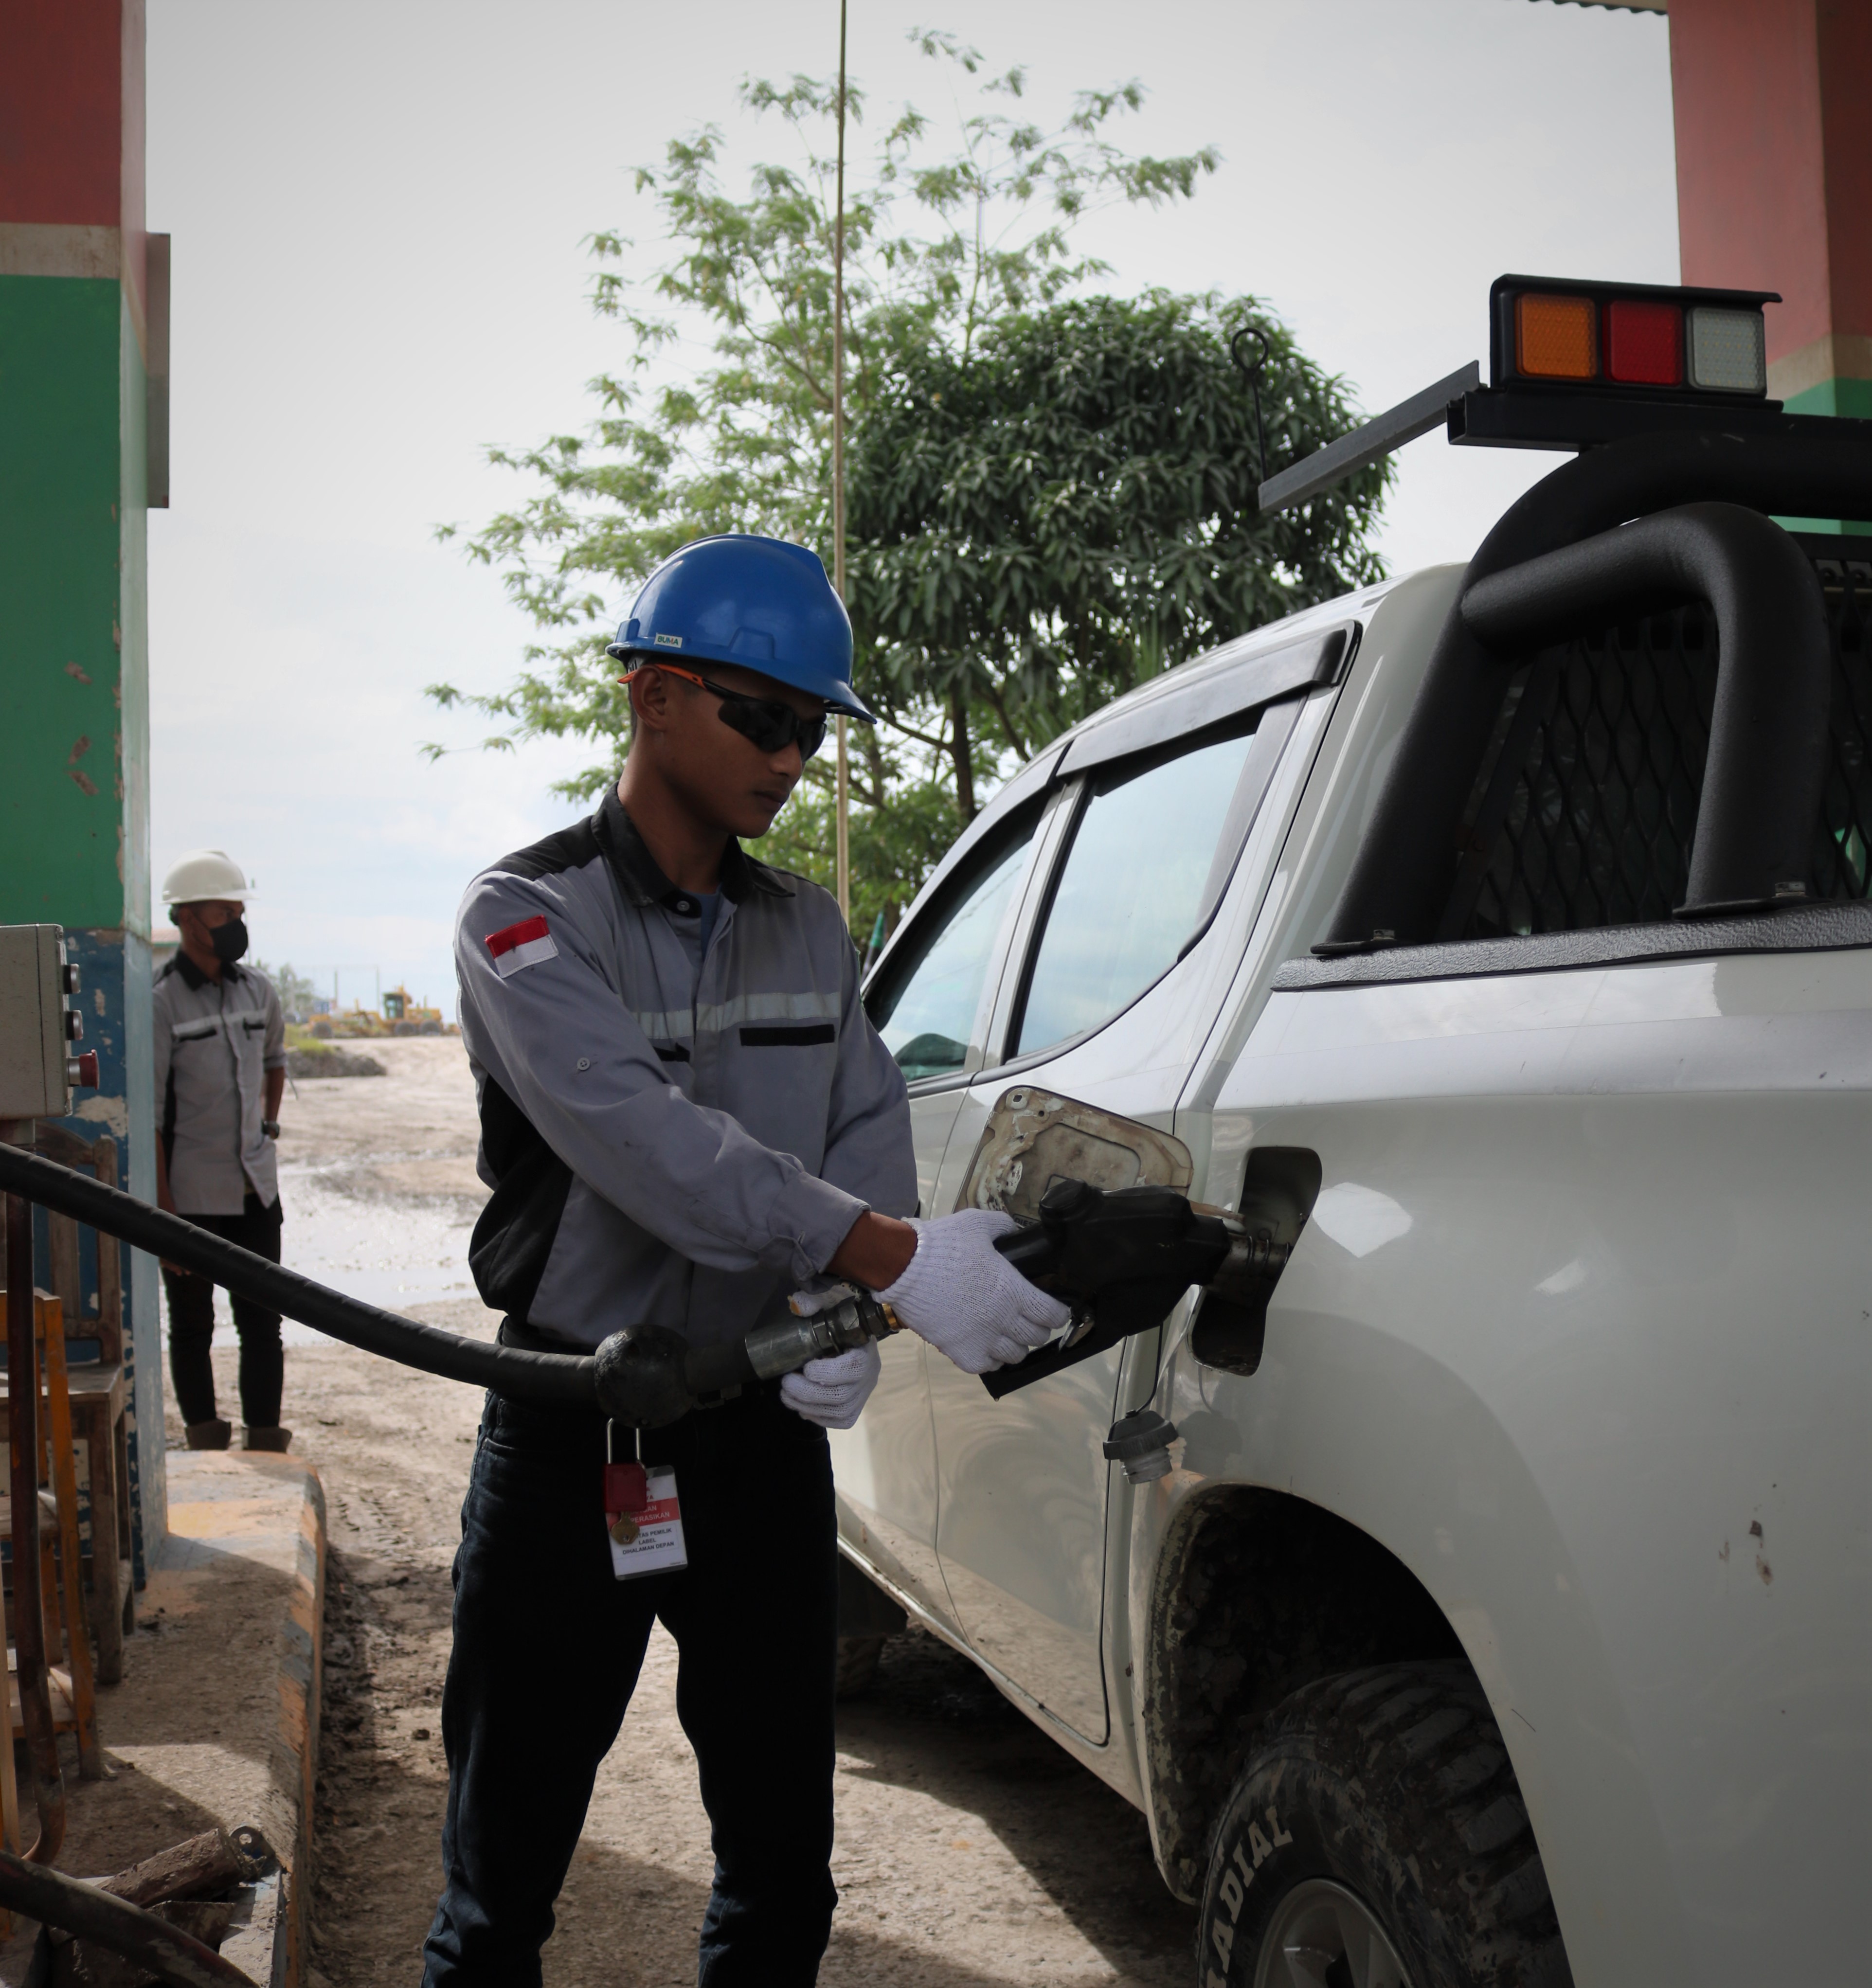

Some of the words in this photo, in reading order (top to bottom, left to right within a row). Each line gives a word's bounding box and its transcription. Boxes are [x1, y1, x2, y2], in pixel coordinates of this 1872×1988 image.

[658, 636, 678, 645] BUMA
[1015, 1218, 1033, 1226] DIES
[630, 1511, 670, 1523] PERASIKAN
[650, 1528, 672, 1536] PEMILIK
[623, 1545, 654, 1555] DIHALAMAN
